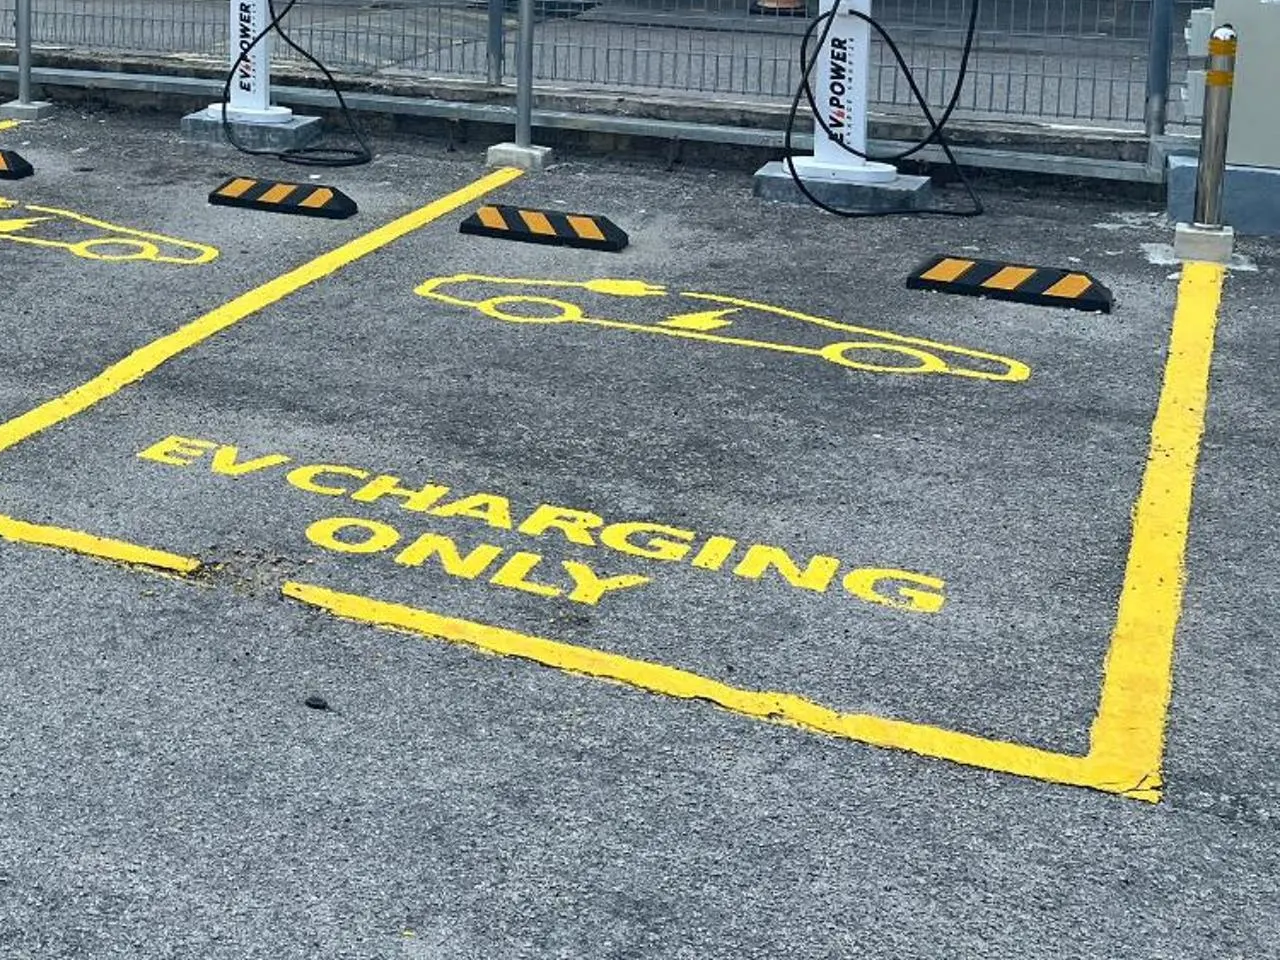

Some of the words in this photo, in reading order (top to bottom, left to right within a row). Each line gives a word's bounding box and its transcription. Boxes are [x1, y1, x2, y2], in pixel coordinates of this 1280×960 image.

[136, 435, 289, 476] EV
[285, 464, 947, 613] CHARGING
[304, 517, 652, 606] ONLY
